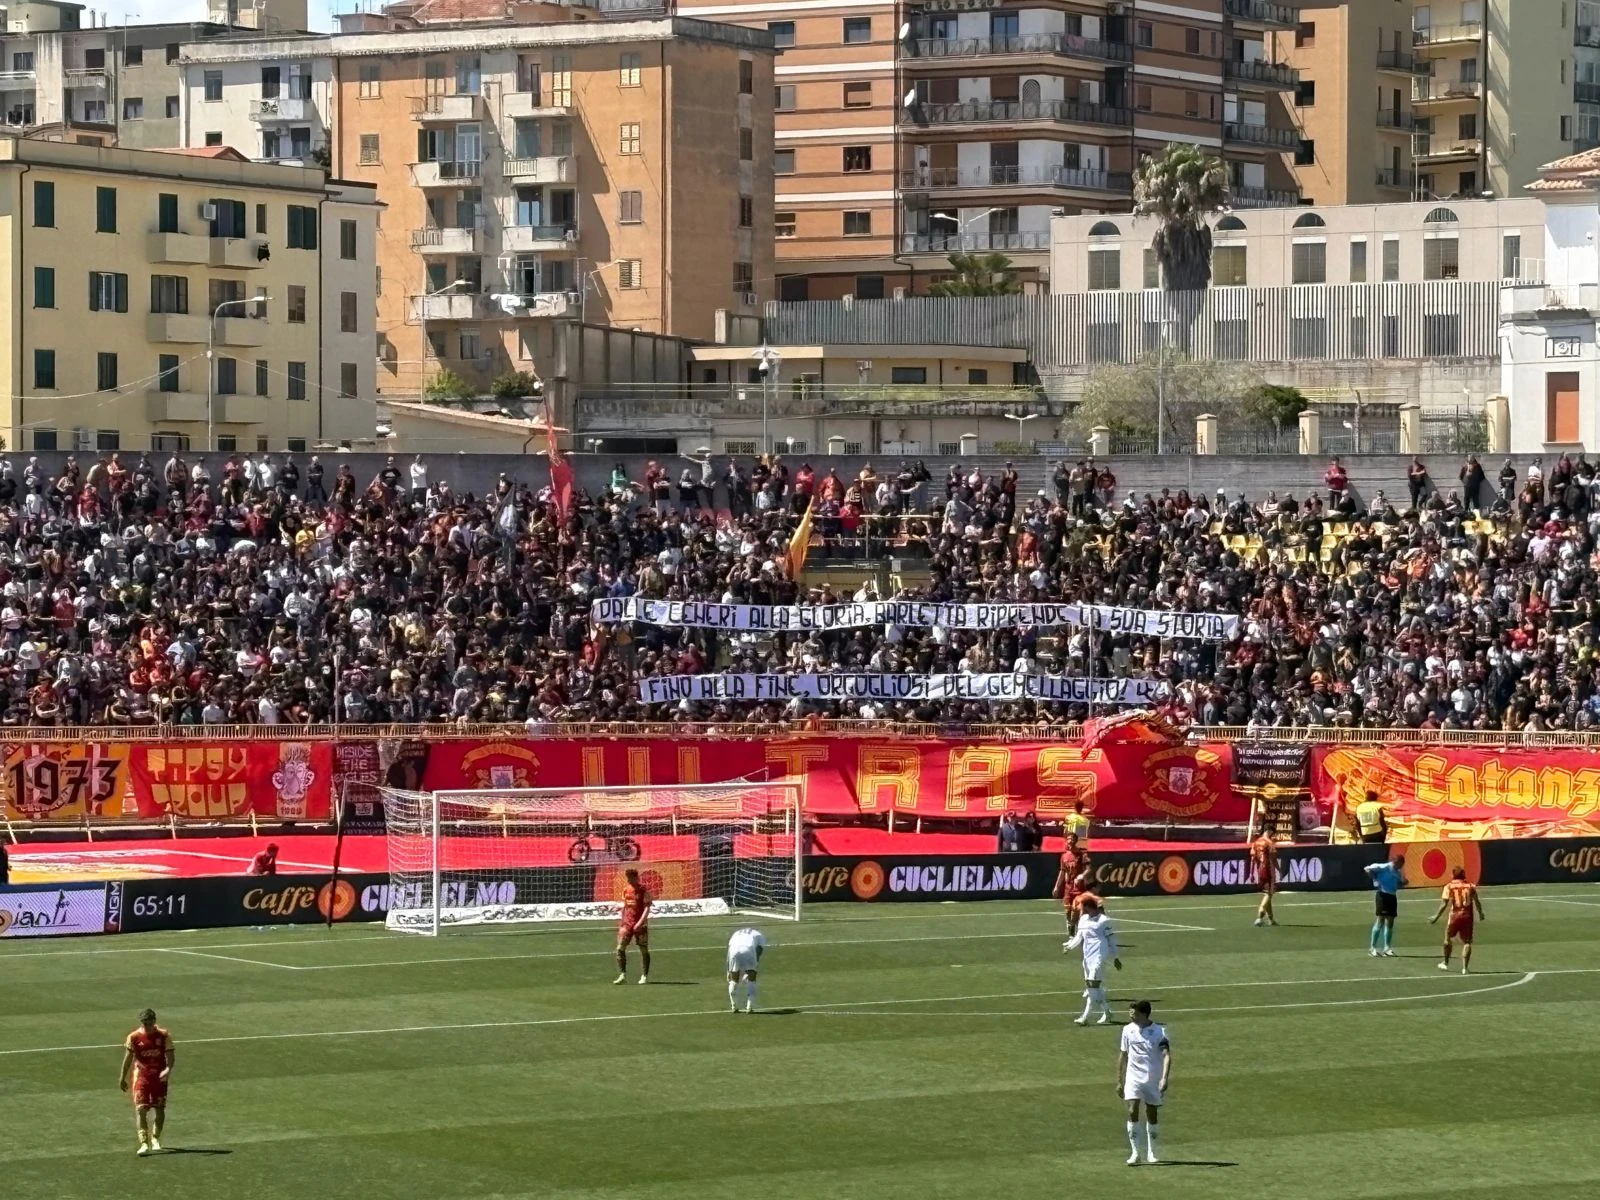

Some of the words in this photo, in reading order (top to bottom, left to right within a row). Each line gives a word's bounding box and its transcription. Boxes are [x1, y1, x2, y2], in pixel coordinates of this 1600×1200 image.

[599, 597, 657, 622] DALLE
[749, 606, 789, 628] ALLA
[875, 602, 966, 627] BARLETTA
[1111, 608, 1146, 632] SUA
[1157, 612, 1224, 638] STORIA
[701, 676, 744, 698] ALLA
[944, 675, 977, 696] DEL
[341, 759, 368, 771] THE
[582, 744, 1101, 812] ULTRAS
[10, 760, 121, 805] 1973
[889, 865, 1028, 892] GUGLIELMO
[1096, 860, 1156, 889] Caffè
[1194, 857, 1323, 886] GUGLILMO
[133, 895, 186, 916] 65:11
[242, 886, 316, 915] Caffè
[361, 881, 515, 911] GUGLELMO
